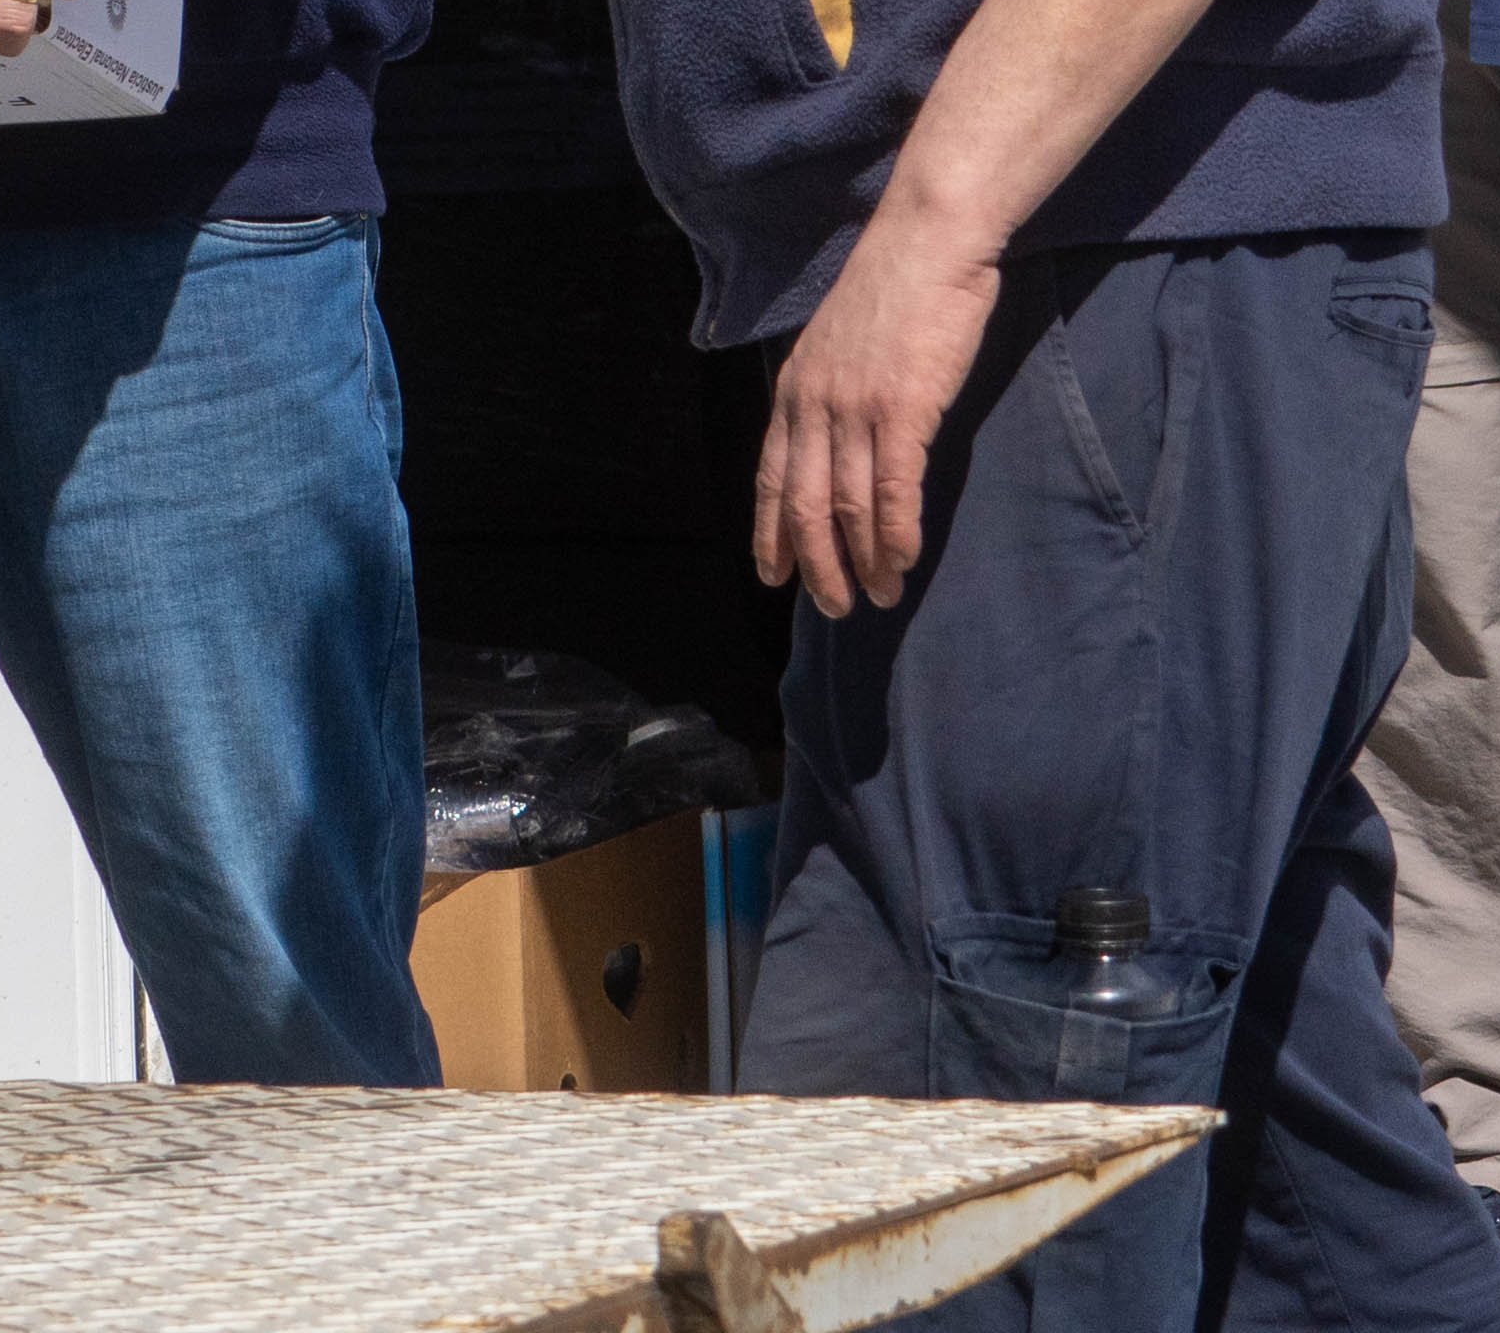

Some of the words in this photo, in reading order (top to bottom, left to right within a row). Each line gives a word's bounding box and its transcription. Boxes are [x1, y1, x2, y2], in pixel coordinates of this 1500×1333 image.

[50, 26, 94, 62] Electoral
[89, 48, 130, 84] Nacional
[128, 69, 164, 101] Justicia
